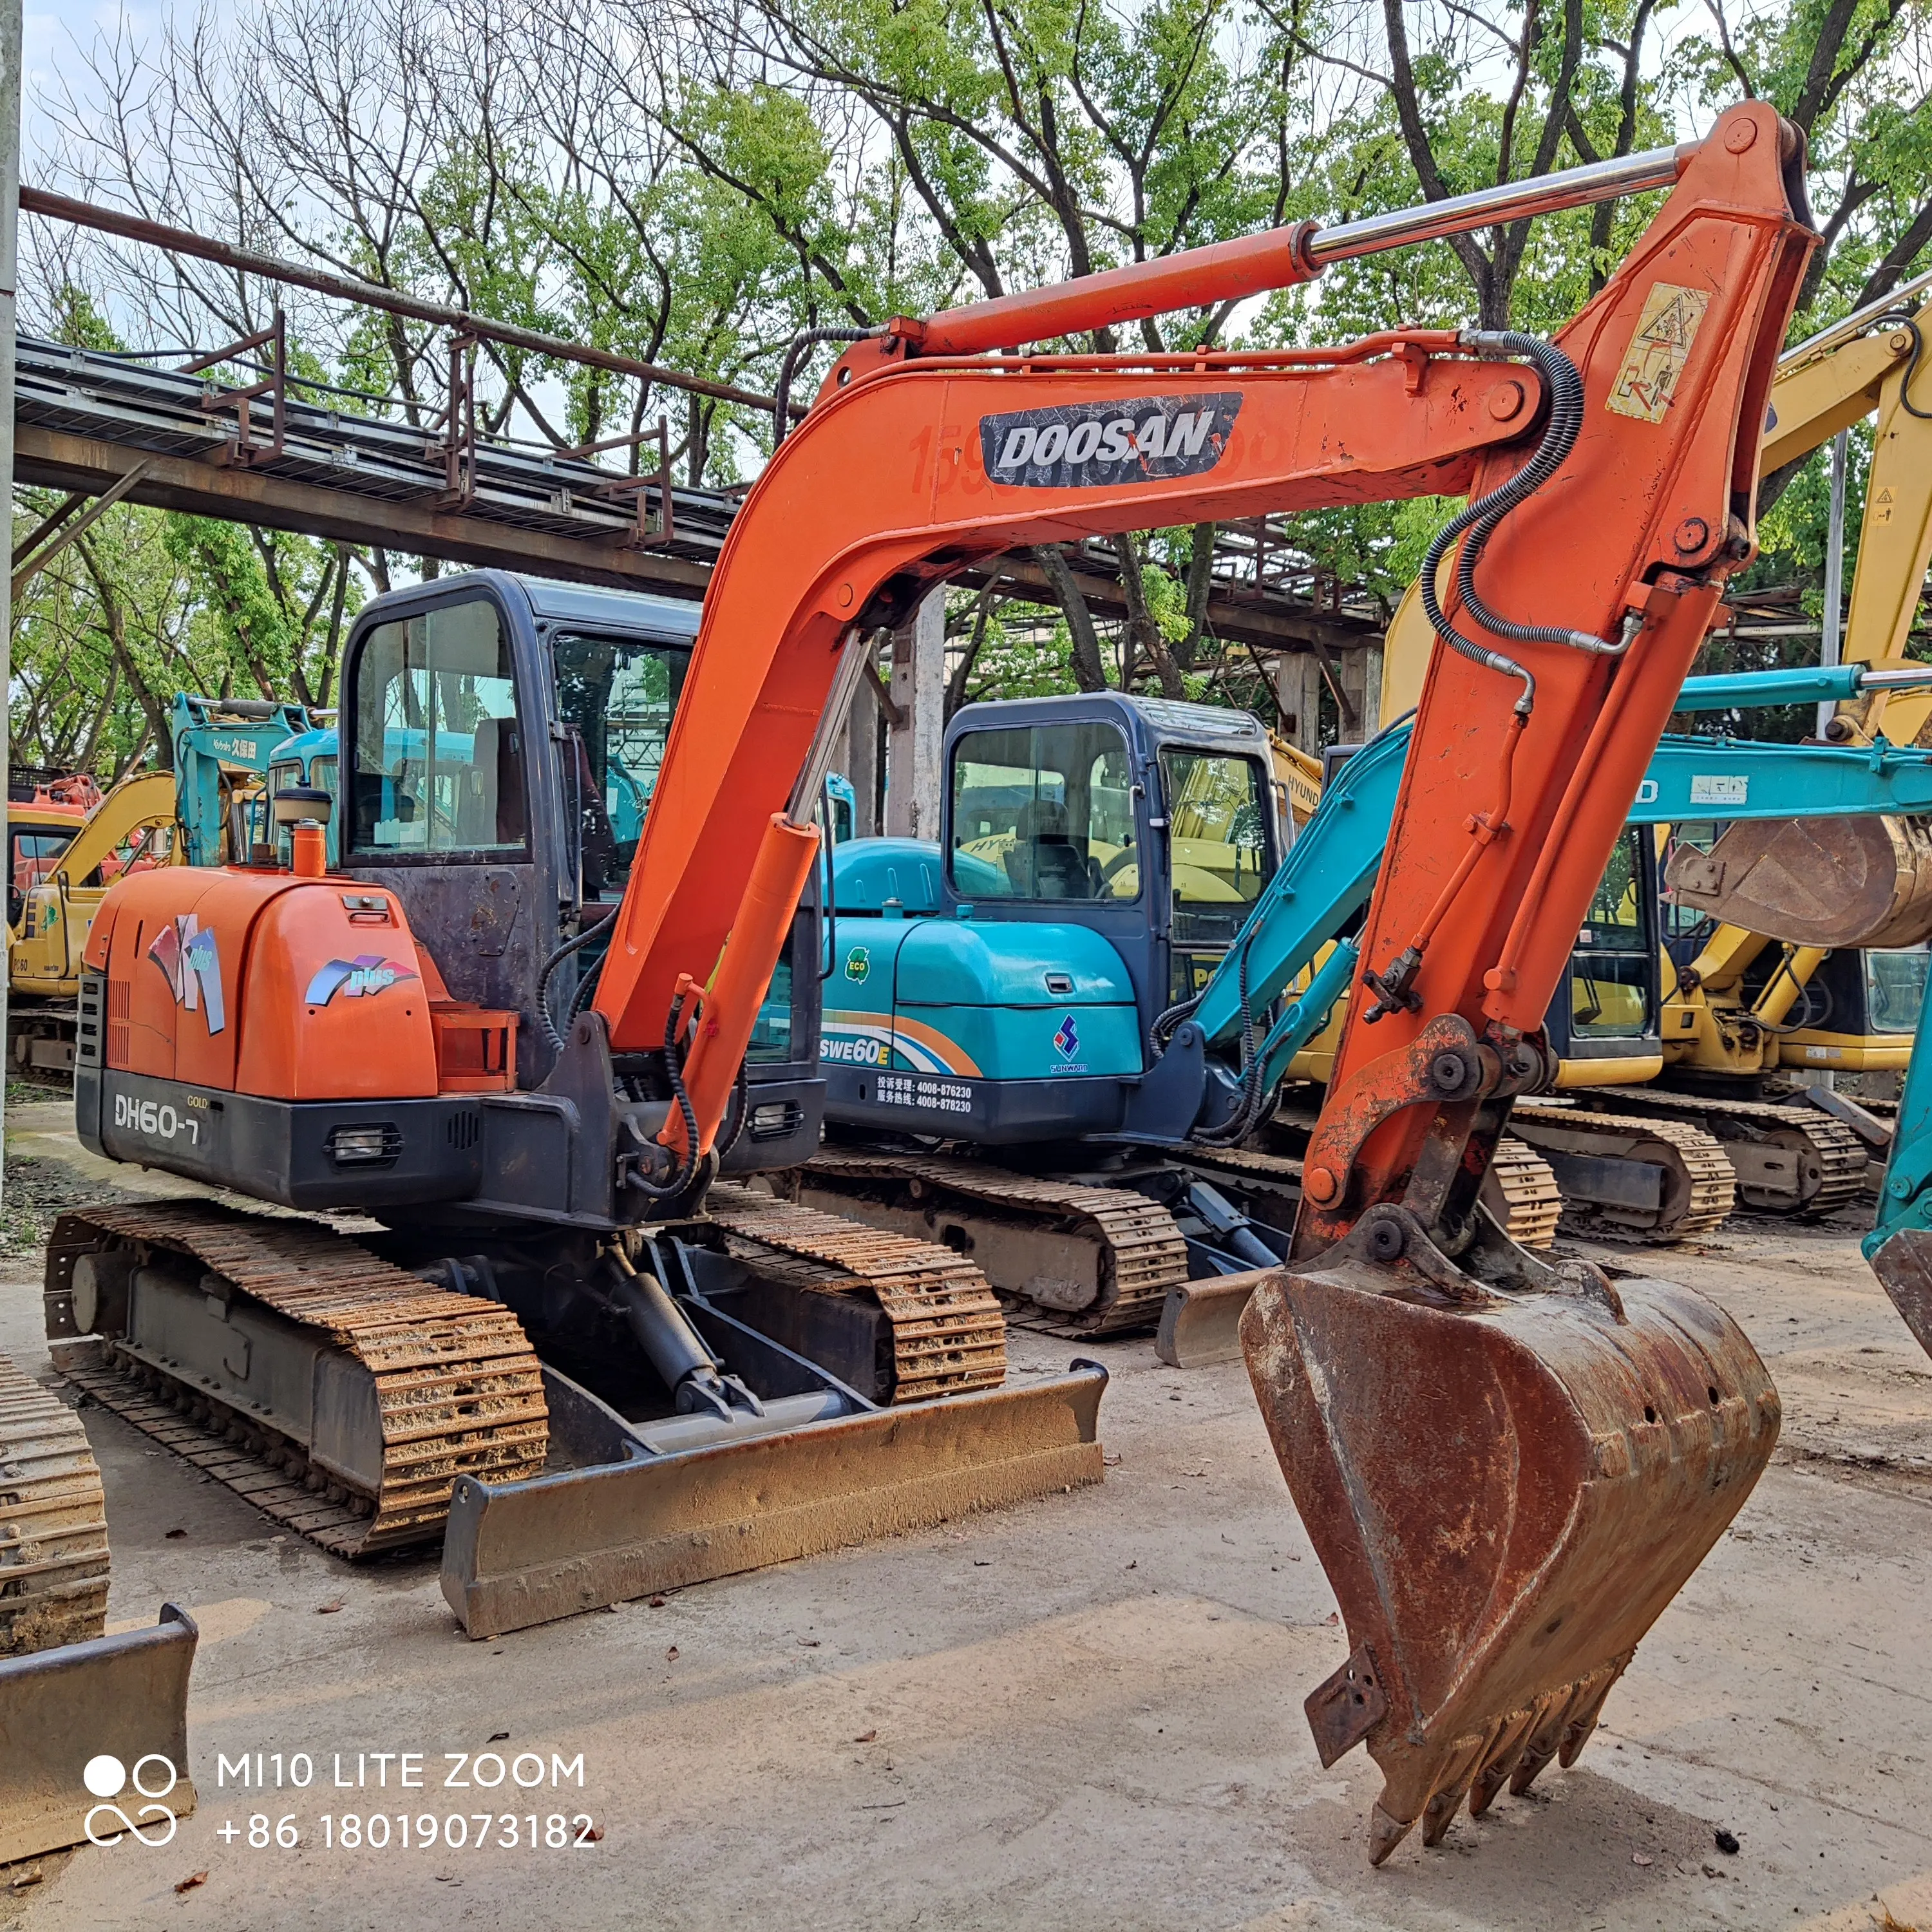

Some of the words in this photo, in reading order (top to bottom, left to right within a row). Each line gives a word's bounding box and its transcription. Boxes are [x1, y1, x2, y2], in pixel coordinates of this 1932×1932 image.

[998, 410, 1215, 468] DOOSAN
[231, 737, 256, 760] 久保田
[849, 962, 865, 971] ECO
[350, 967, 395, 990] plus
[820, 1038, 890, 1065] SWE60E
[1050, 1064, 1088, 1073] SUNWARD
[917, 1081, 971, 1099] 4008-876230
[187, 1095, 207, 1109] GOLD
[917, 1095, 971, 1113] 4008-878230
[115, 1094, 198, 1144] DH60-7
